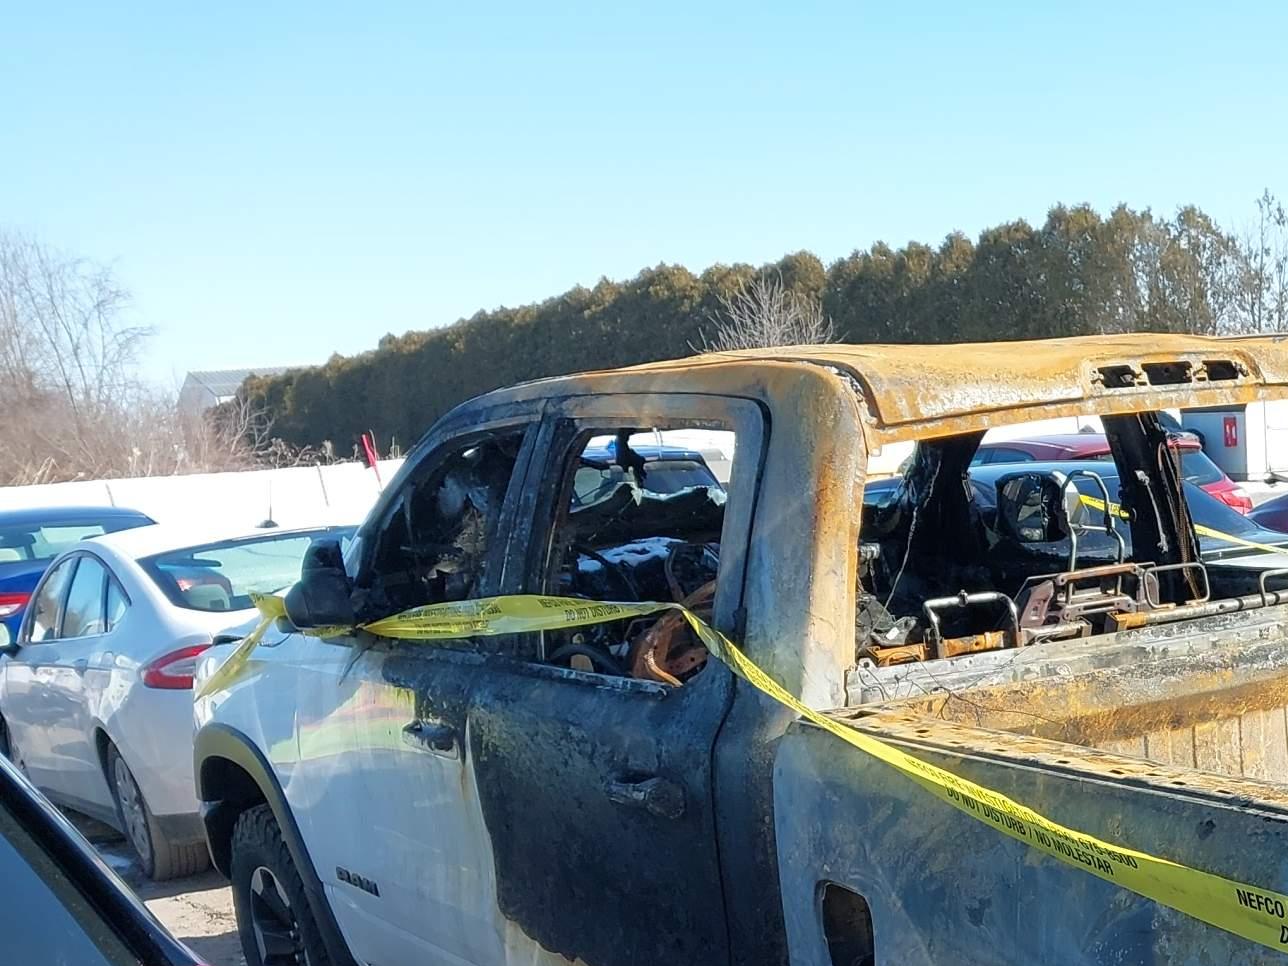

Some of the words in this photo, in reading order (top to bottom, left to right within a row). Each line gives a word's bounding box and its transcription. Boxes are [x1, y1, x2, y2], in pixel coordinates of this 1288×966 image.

[984, 804, 1026, 836] DISTURB
[1035, 829, 1051, 848] NO
[1053, 838, 1115, 876] MOLESTAR
[1236, 888, 1286, 919] NEFCO
